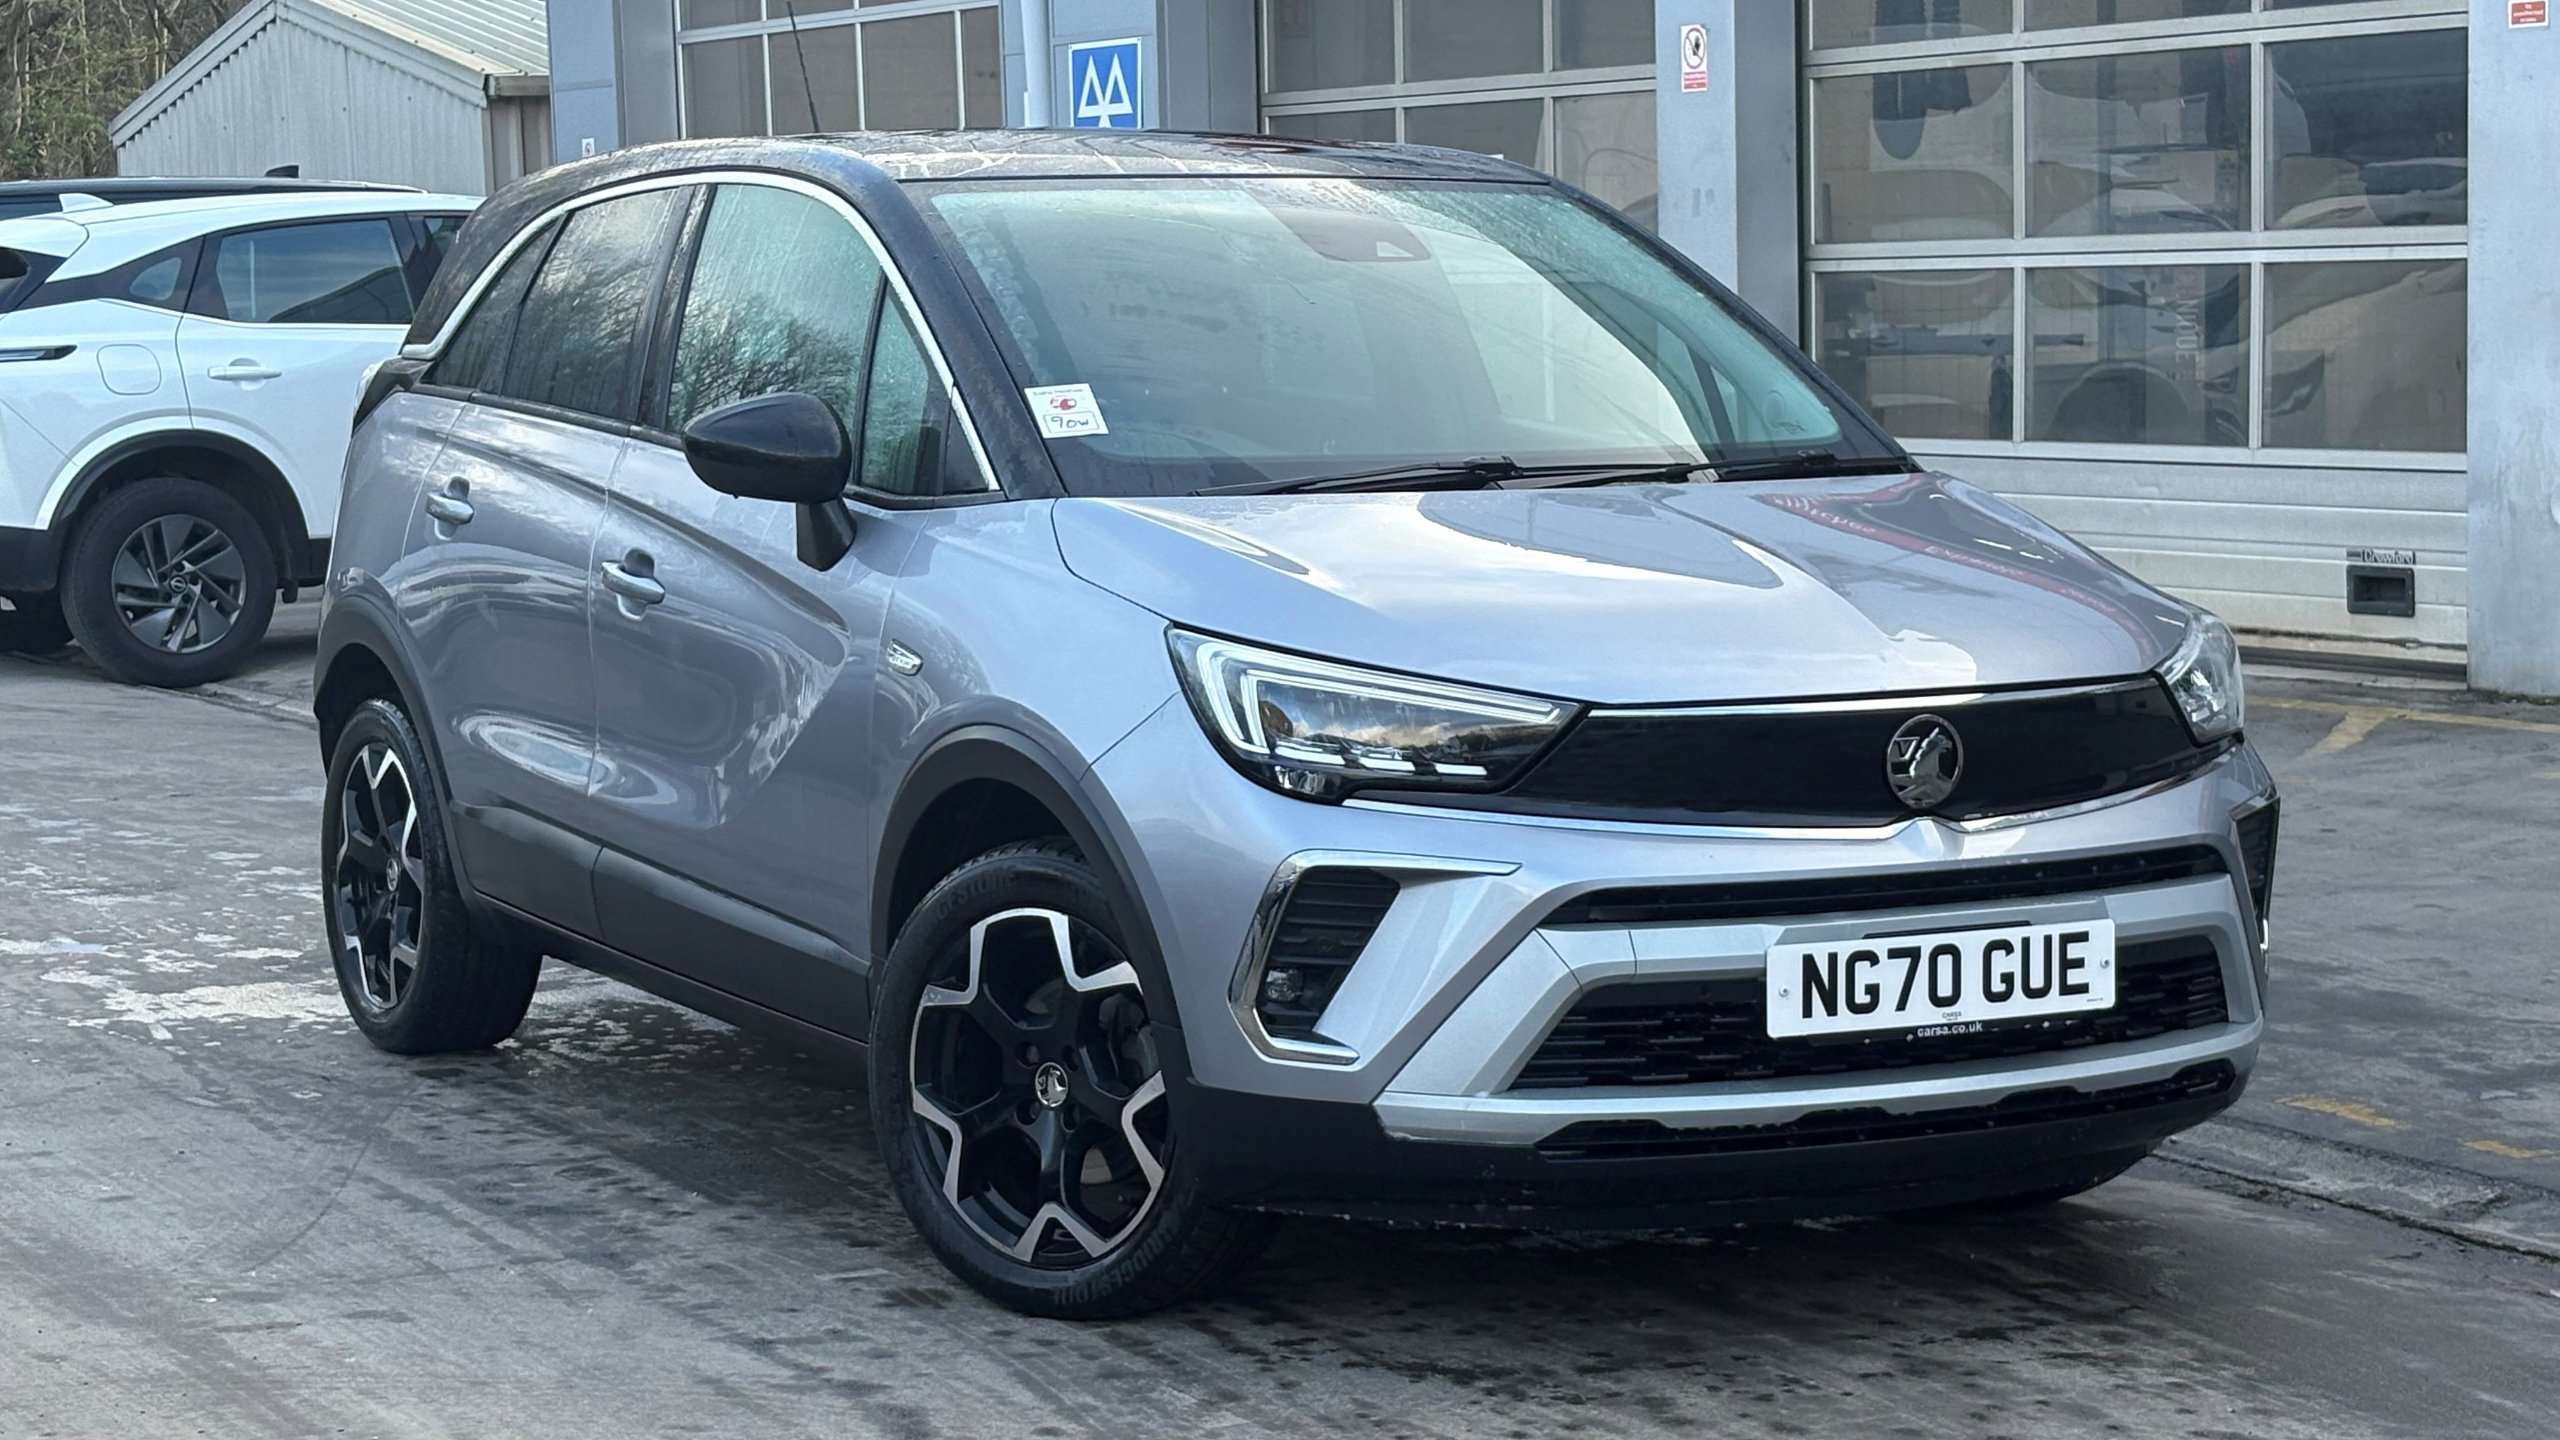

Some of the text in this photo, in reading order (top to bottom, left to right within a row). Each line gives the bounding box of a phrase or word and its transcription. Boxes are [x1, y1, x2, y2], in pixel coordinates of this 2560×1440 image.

[1802, 930, 2090, 1019] NG70 GUE
[1917, 1020, 1983, 1038] carsa.co.uk
